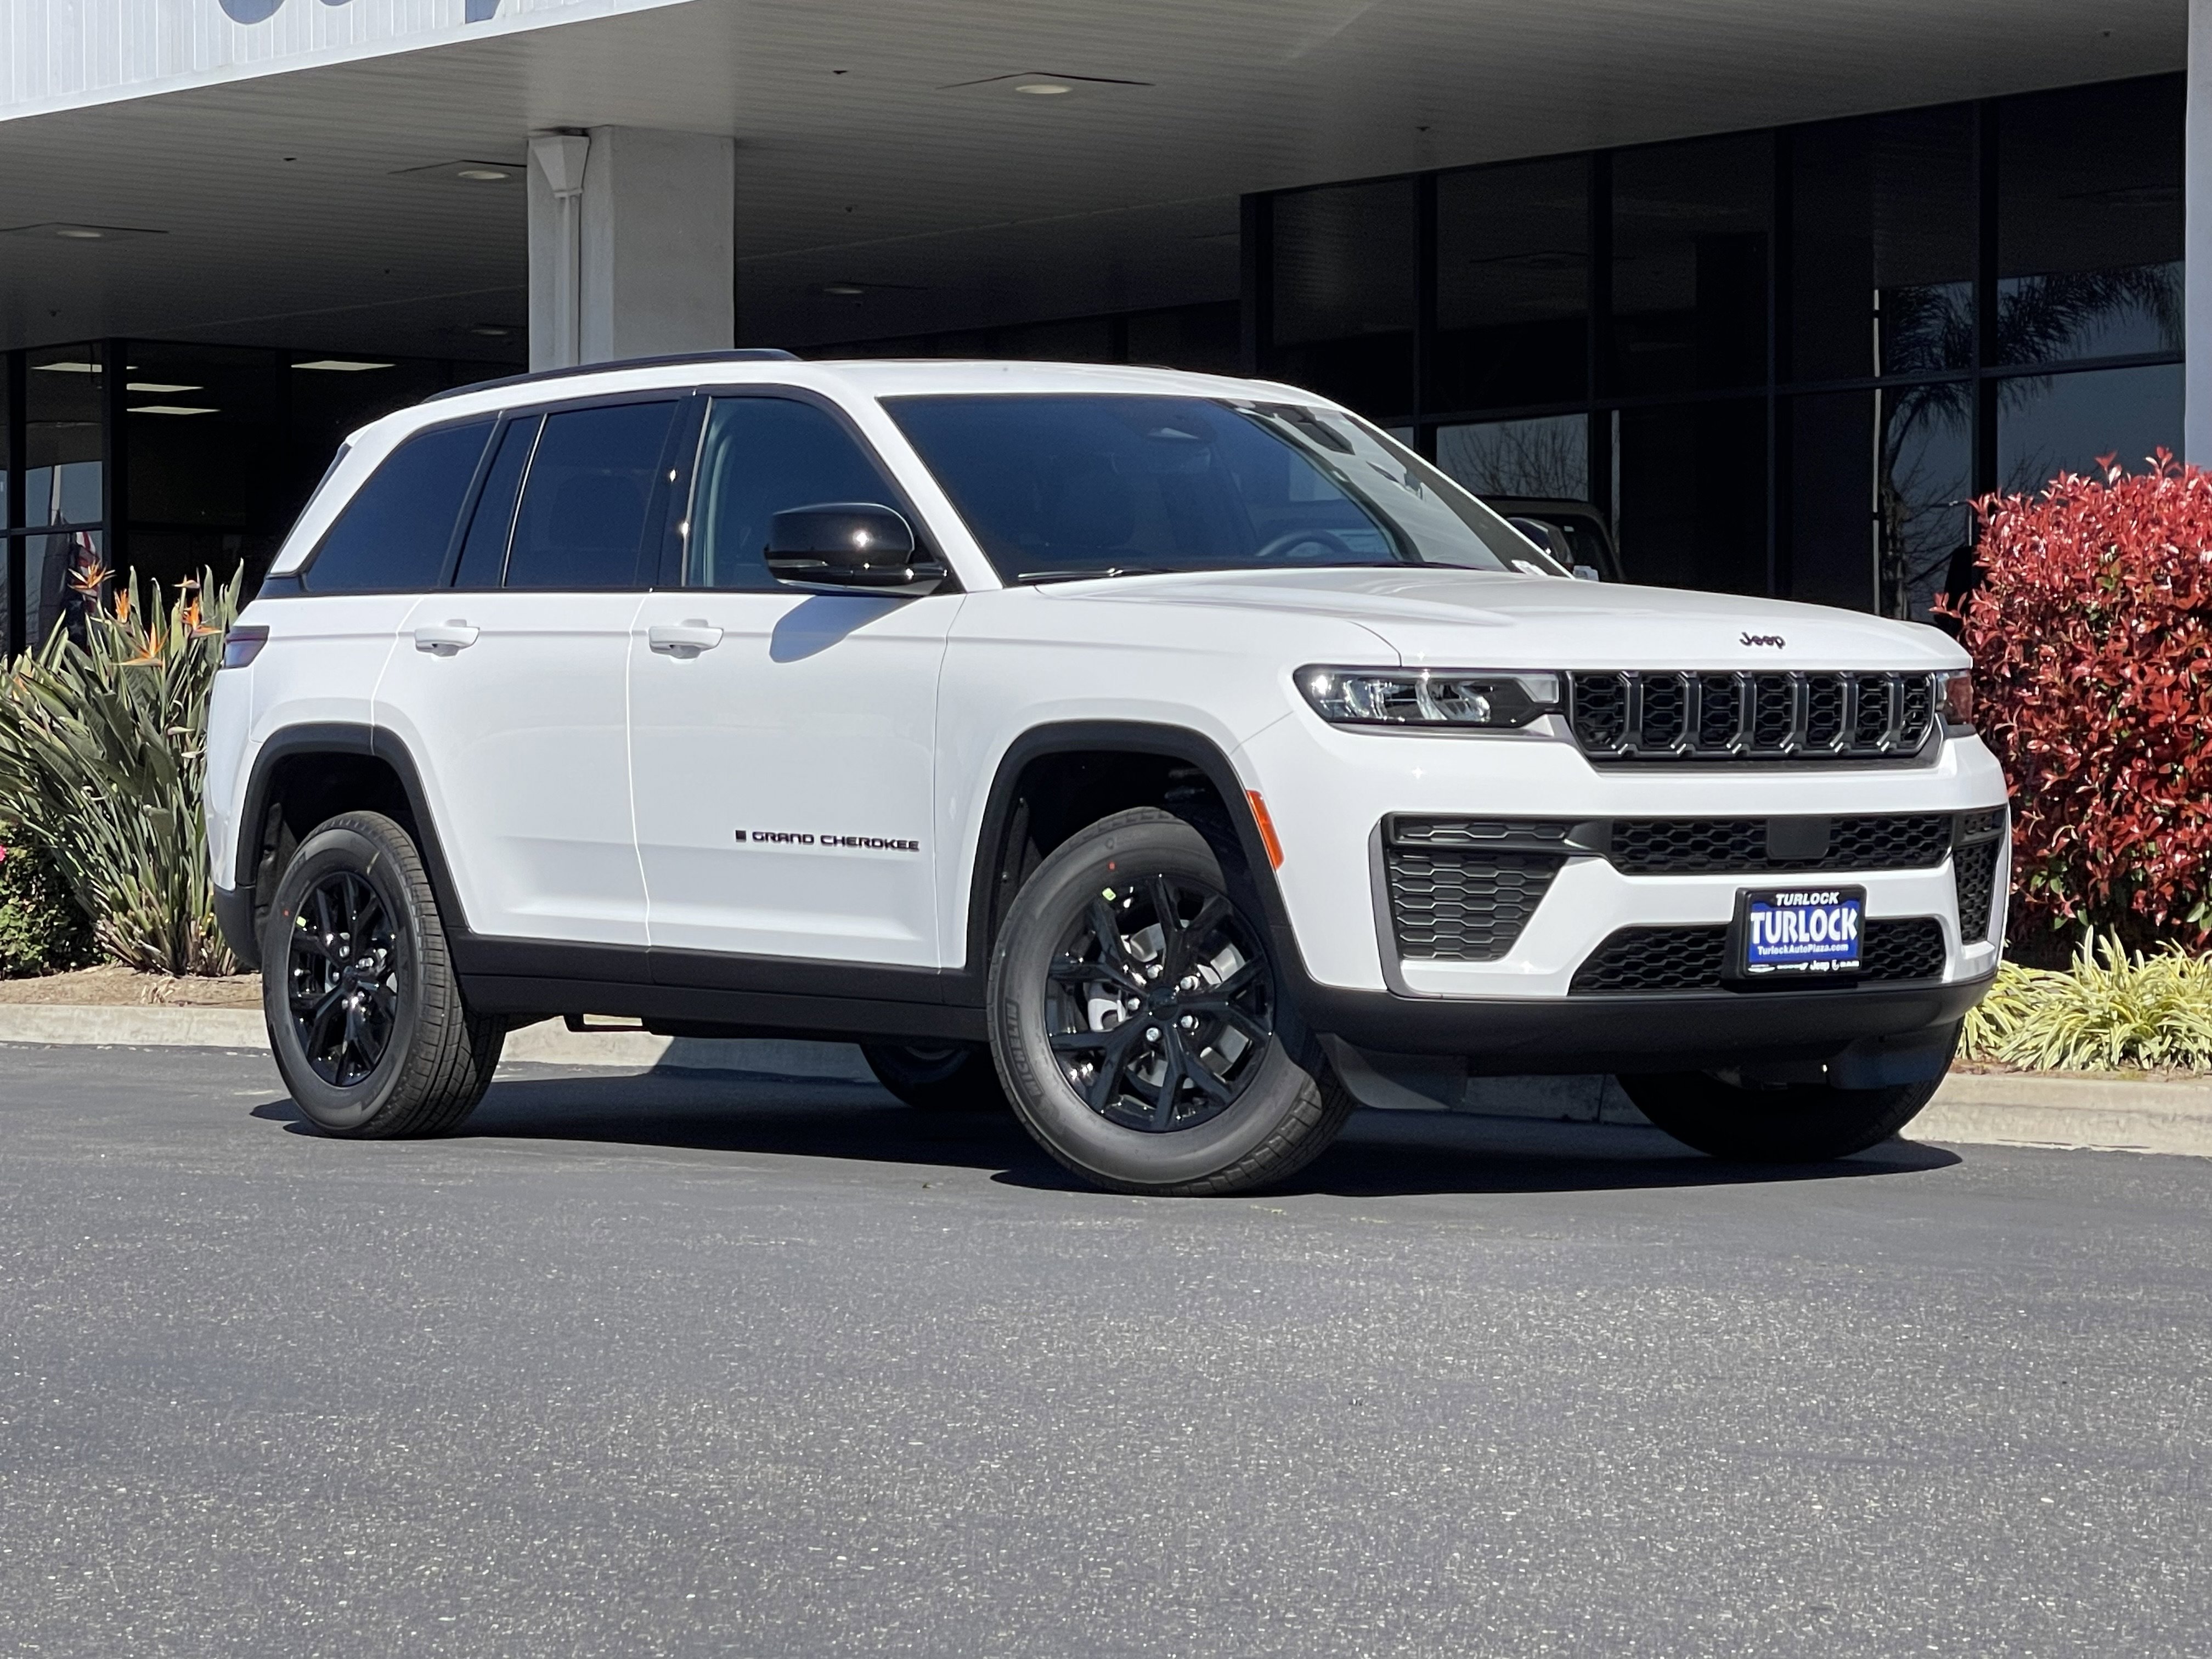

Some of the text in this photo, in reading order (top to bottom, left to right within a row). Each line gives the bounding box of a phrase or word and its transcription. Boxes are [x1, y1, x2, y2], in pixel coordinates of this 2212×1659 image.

[1739, 631, 1786, 650] Jeep
[752, 831, 919, 851] GRAND CHEROKEE
[1776, 892, 1839, 906] TURLOCK
[1751, 909, 1858, 944] TURLOCK
[1757, 944, 1849, 955] TurlockAutoPlaza.com
[1007, 1003, 1042, 1097] MICHELIN
